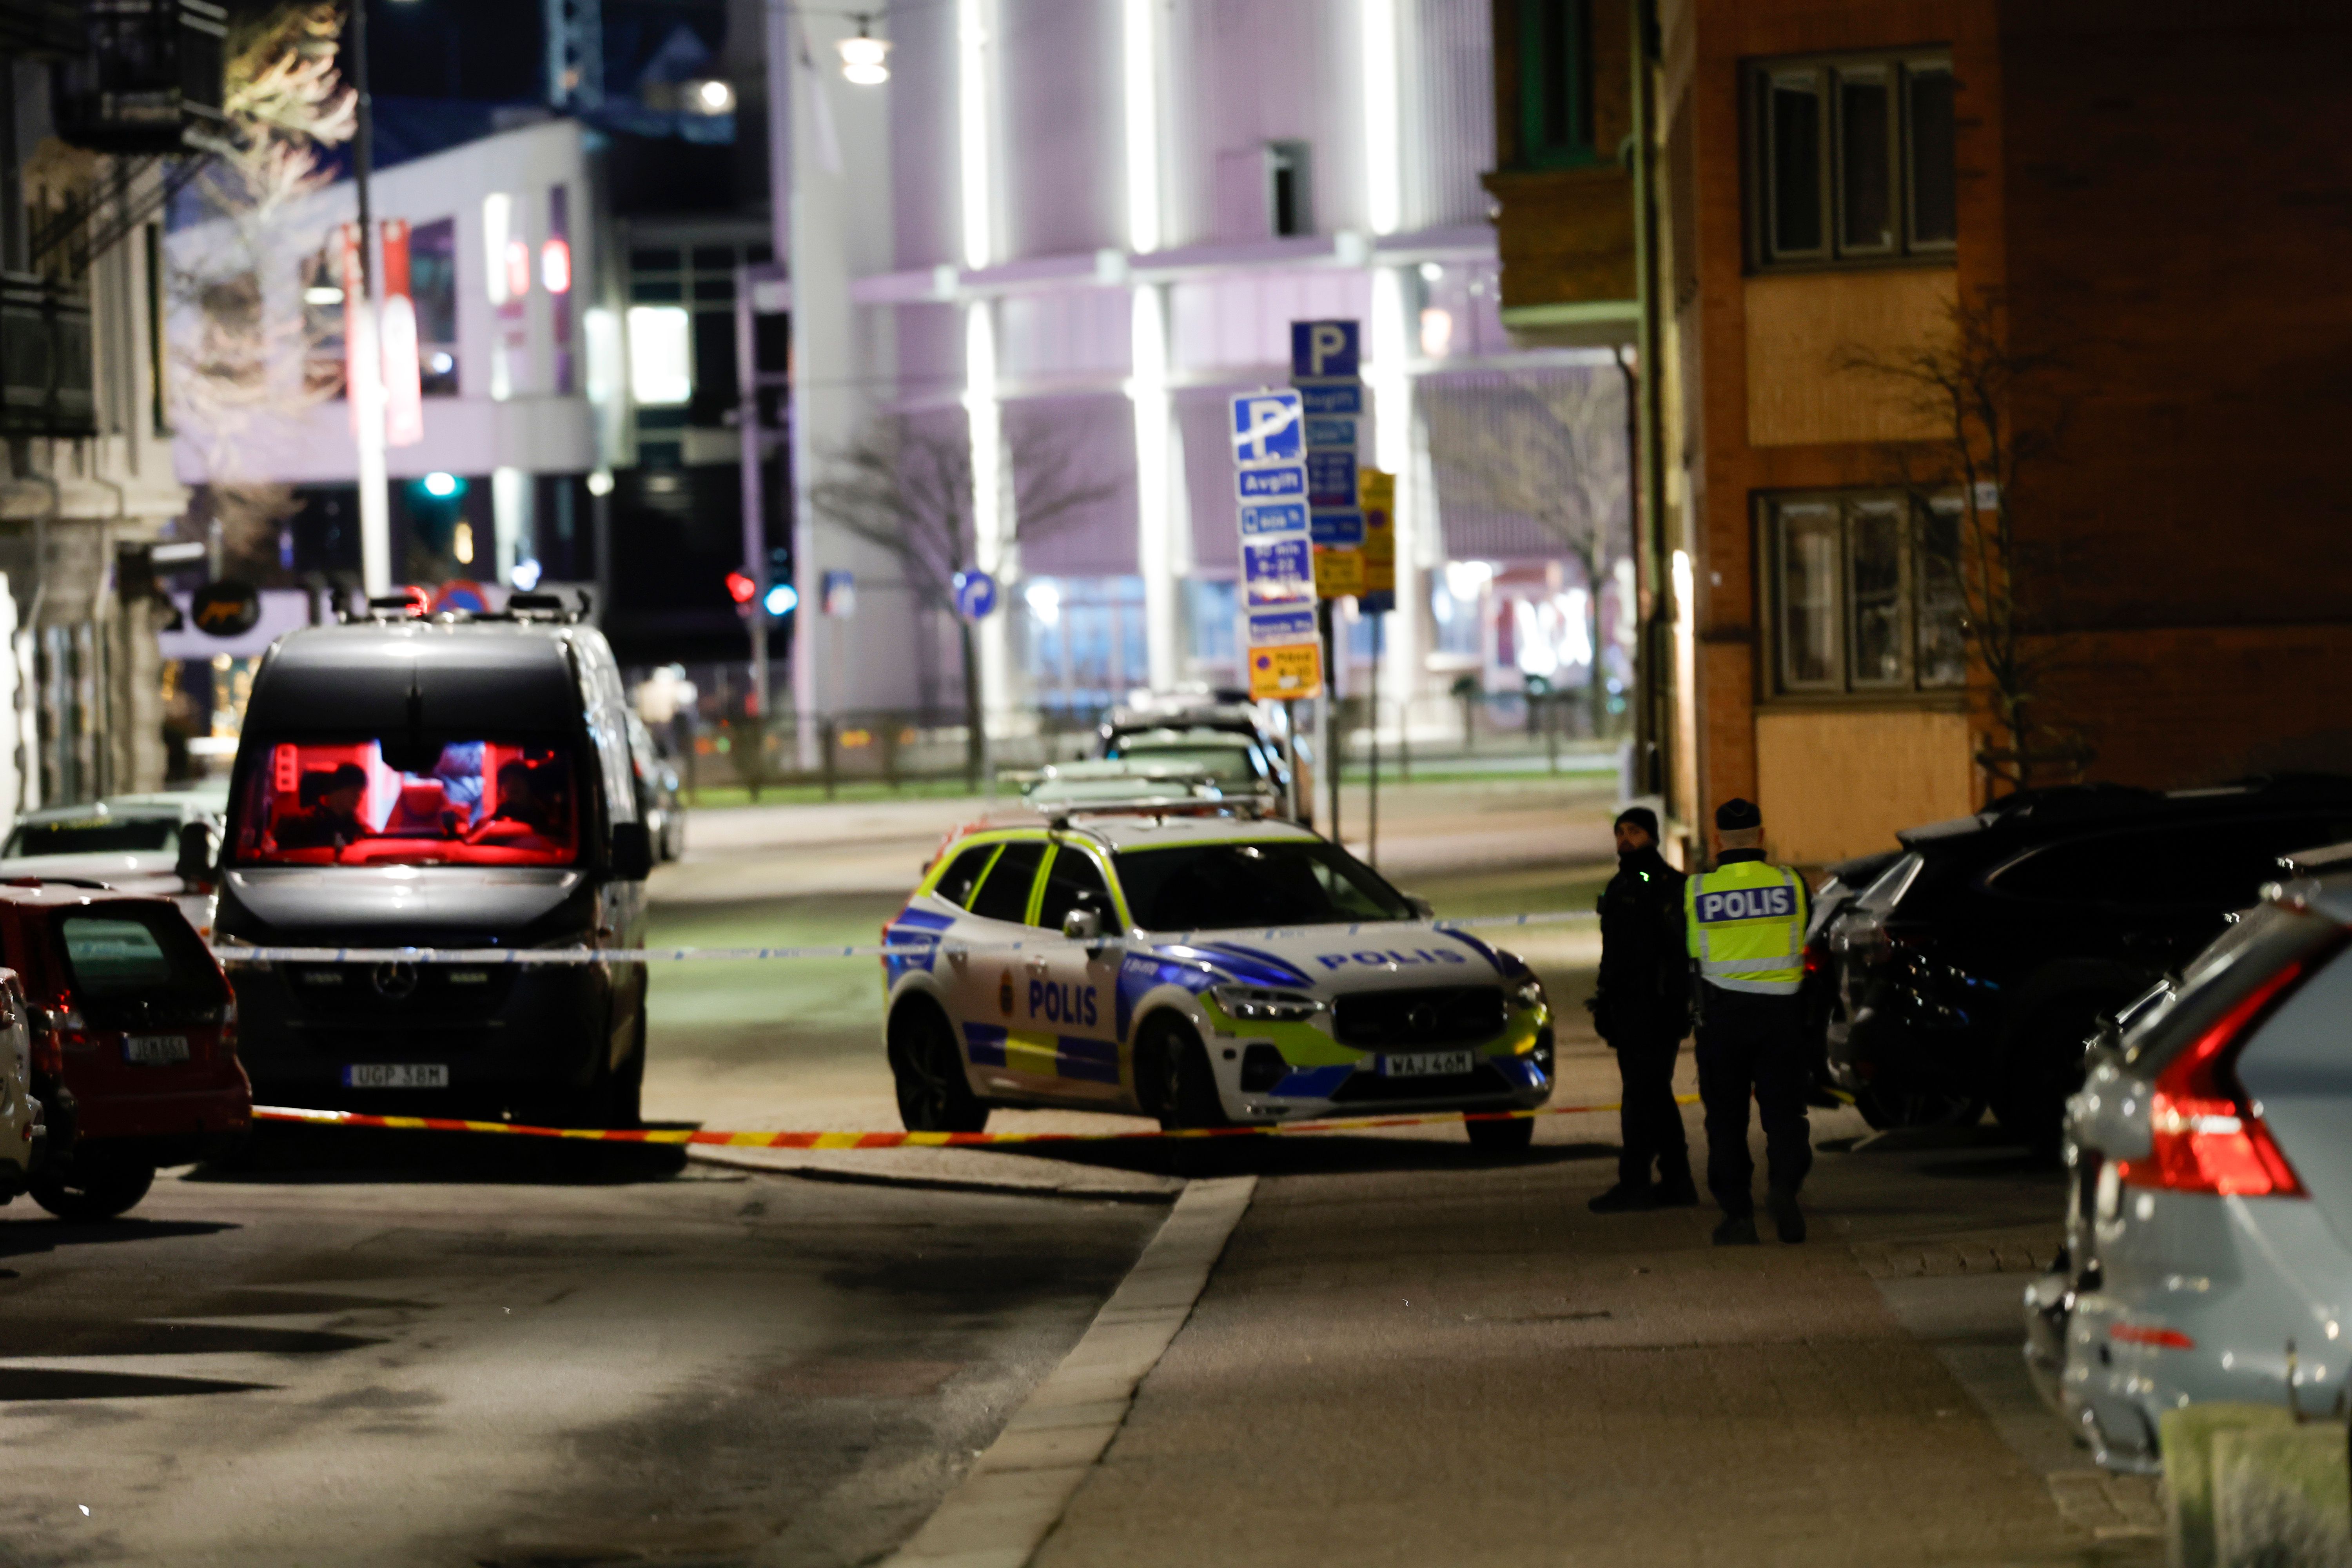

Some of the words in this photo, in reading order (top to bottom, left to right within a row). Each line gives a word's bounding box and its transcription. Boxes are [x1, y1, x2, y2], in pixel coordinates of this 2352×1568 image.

[1310, 325, 1347, 376] P
[1249, 399, 1290, 460] P
[1245, 473, 1298, 492] Avgift
[1703, 887, 1789, 920] POLIS
[1316, 949, 1466, 971] POLIS
[1029, 979, 1097, 1026] POLIS
[358, 1065, 396, 1085] UGP
